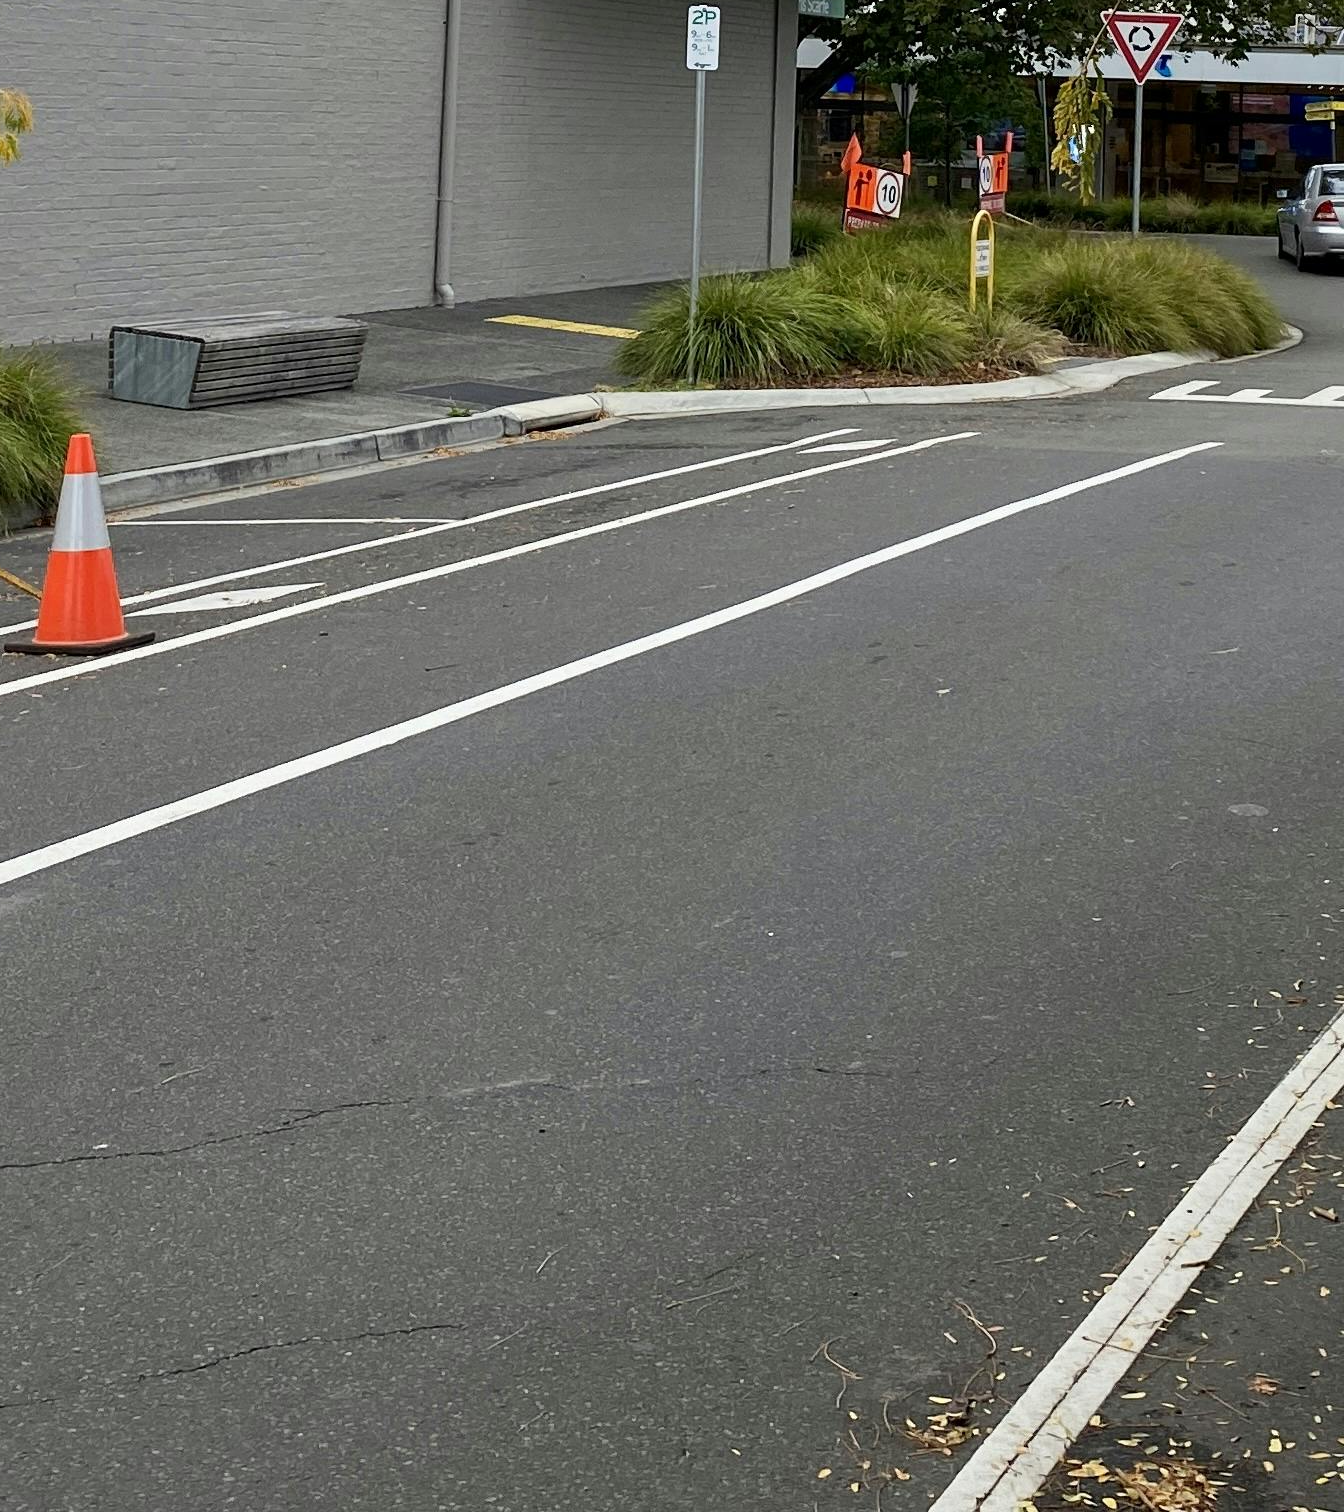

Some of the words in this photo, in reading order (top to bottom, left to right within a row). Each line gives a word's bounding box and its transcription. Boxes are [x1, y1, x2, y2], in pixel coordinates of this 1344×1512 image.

[692, 9, 717, 25] 2P
[982, 165, 990, 183] 10
[881, 183, 896, 204] 10
